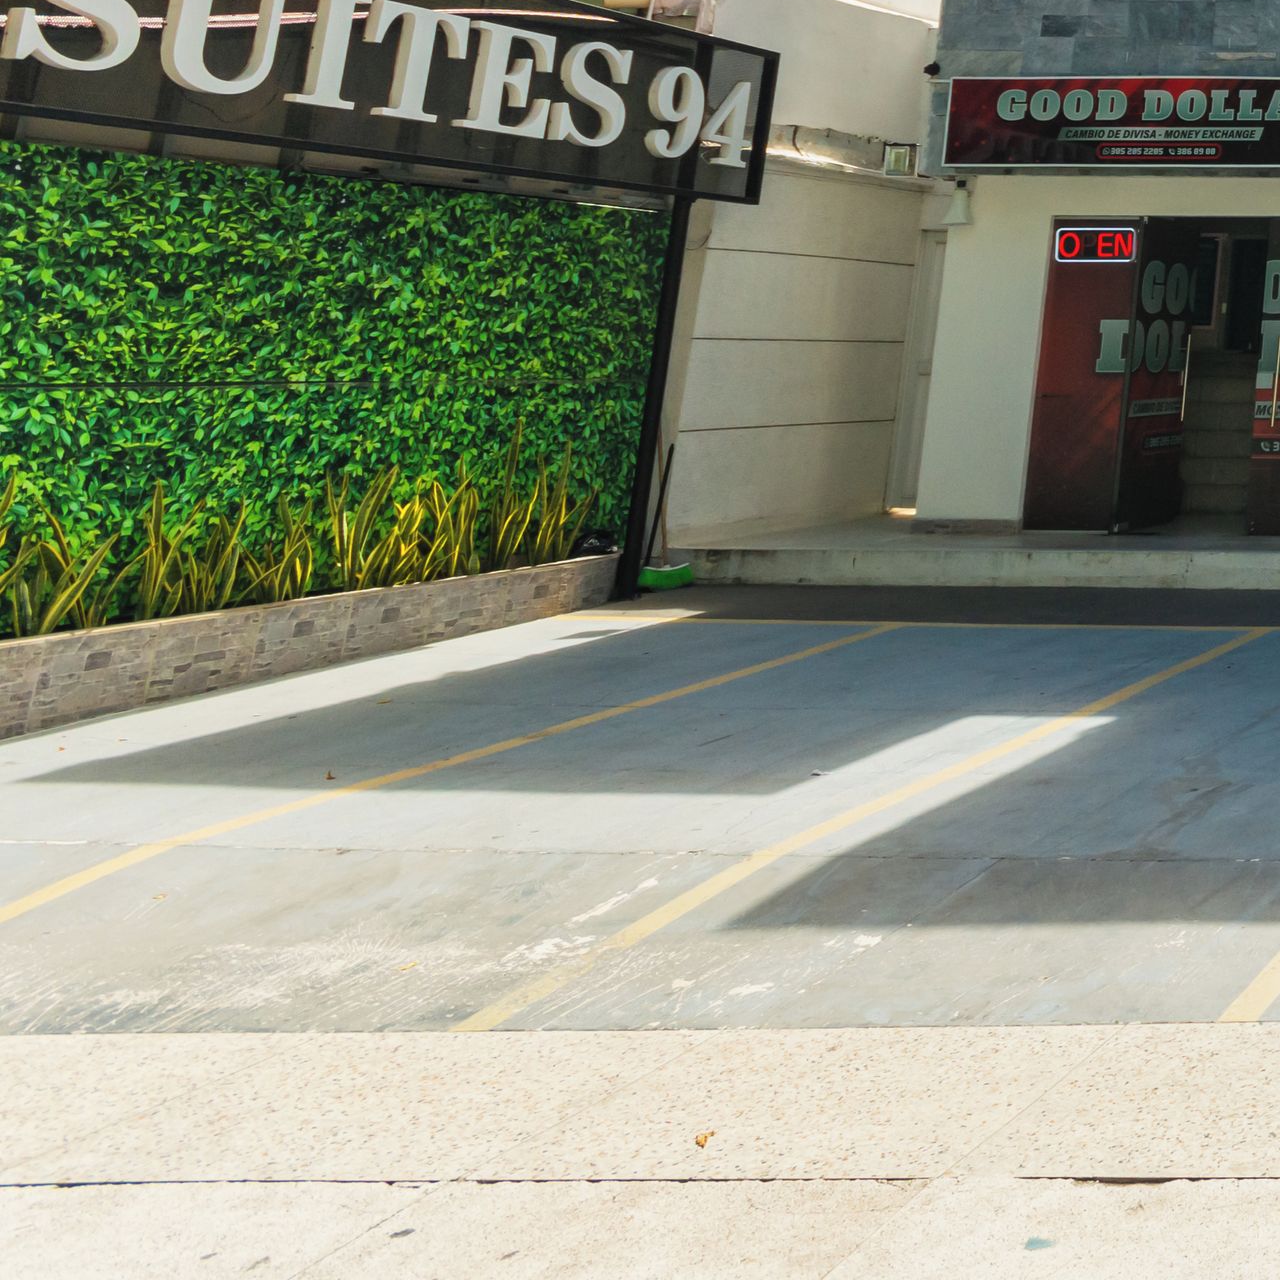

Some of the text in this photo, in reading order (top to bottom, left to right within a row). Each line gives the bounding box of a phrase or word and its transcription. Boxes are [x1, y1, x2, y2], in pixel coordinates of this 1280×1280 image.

[644, 64, 754, 169] 94
[996, 88, 1128, 121] GOOD
[1065, 129, 1105, 139] CAMBIO
[1109, 129, 1121, 139] DE
[1123, 129, 1157, 139] DIVISA
[1164, 129, 1201, 139] MONEY
[1202, 129, 1256, 139] EXCHANGE
[1058, 232, 1134, 258] OPEN
